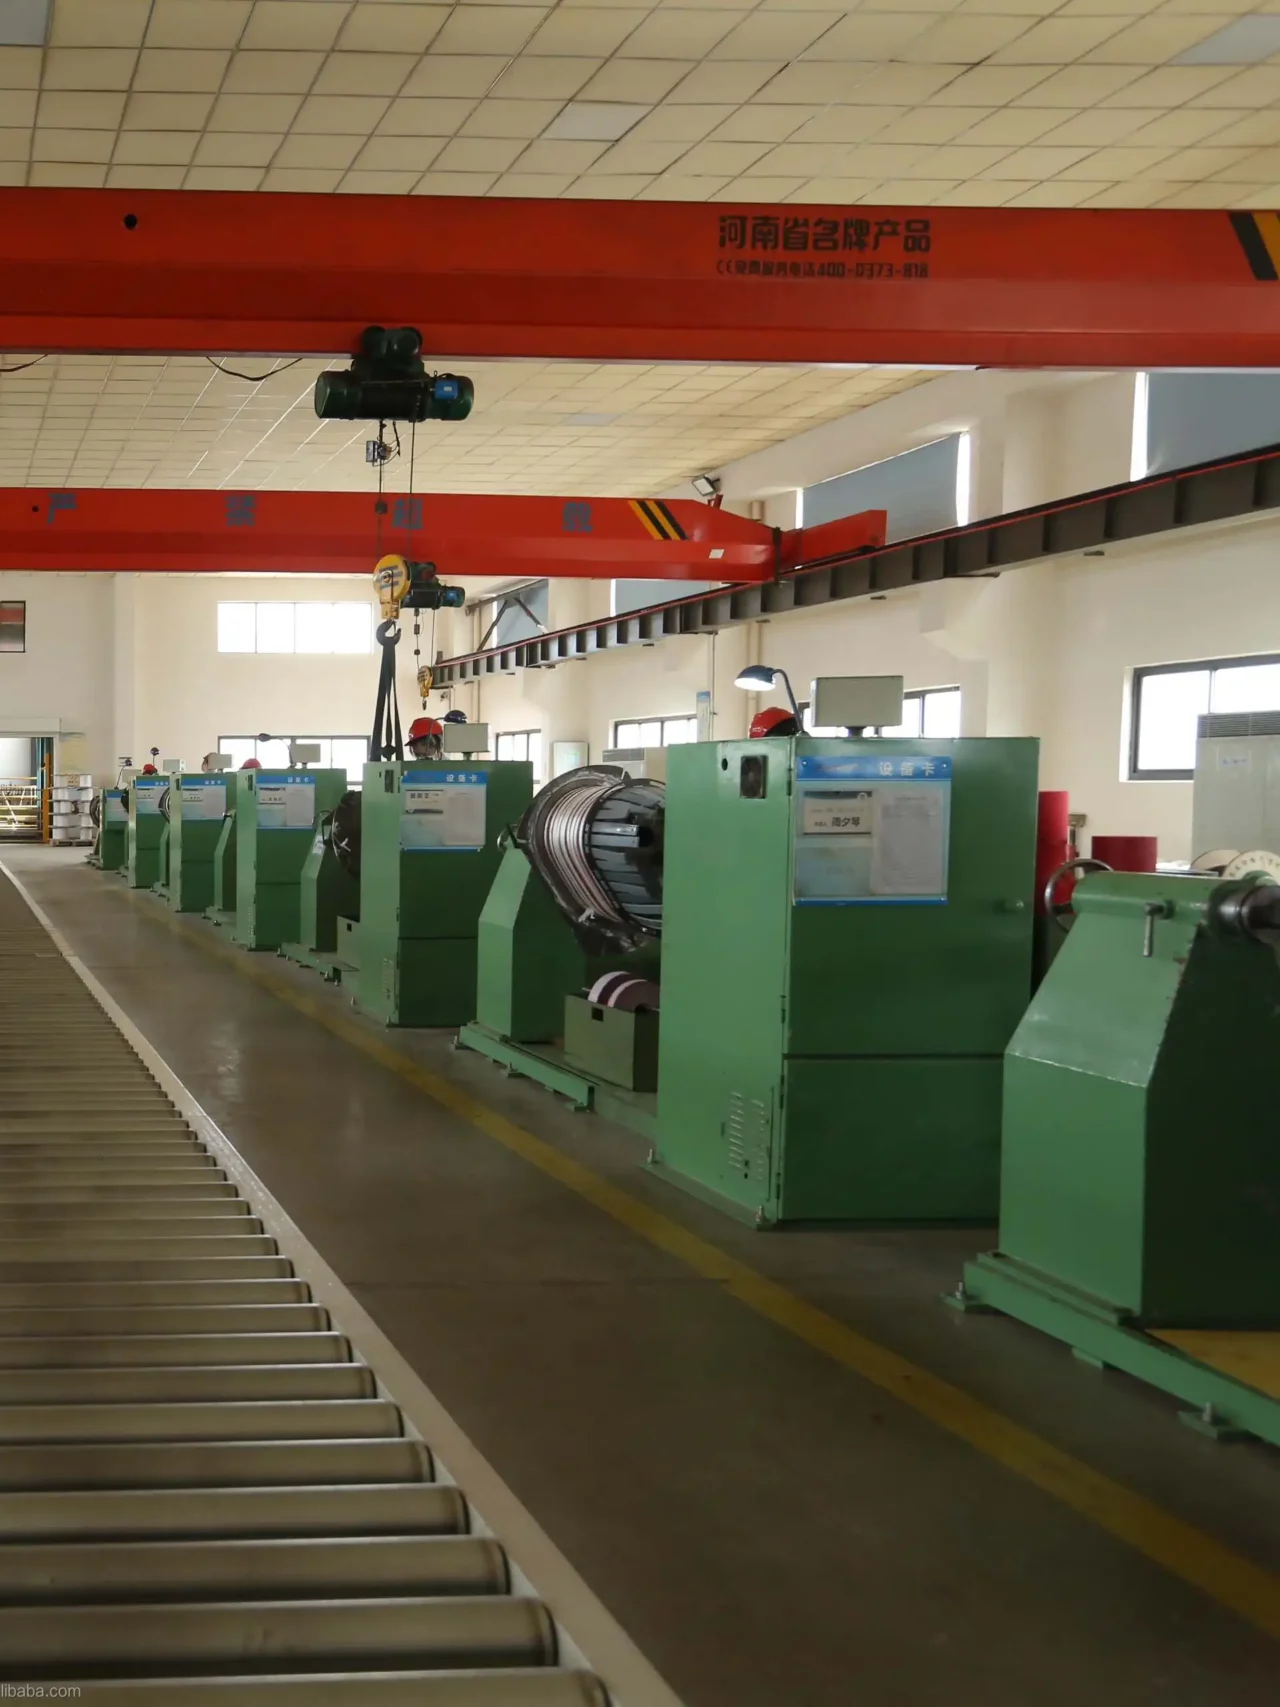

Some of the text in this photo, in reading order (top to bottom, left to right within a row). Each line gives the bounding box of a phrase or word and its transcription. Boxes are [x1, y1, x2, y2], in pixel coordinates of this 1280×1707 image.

[718, 214, 931, 253] 河南省名牌产品
[879, 761, 935, 777] 设备卡
